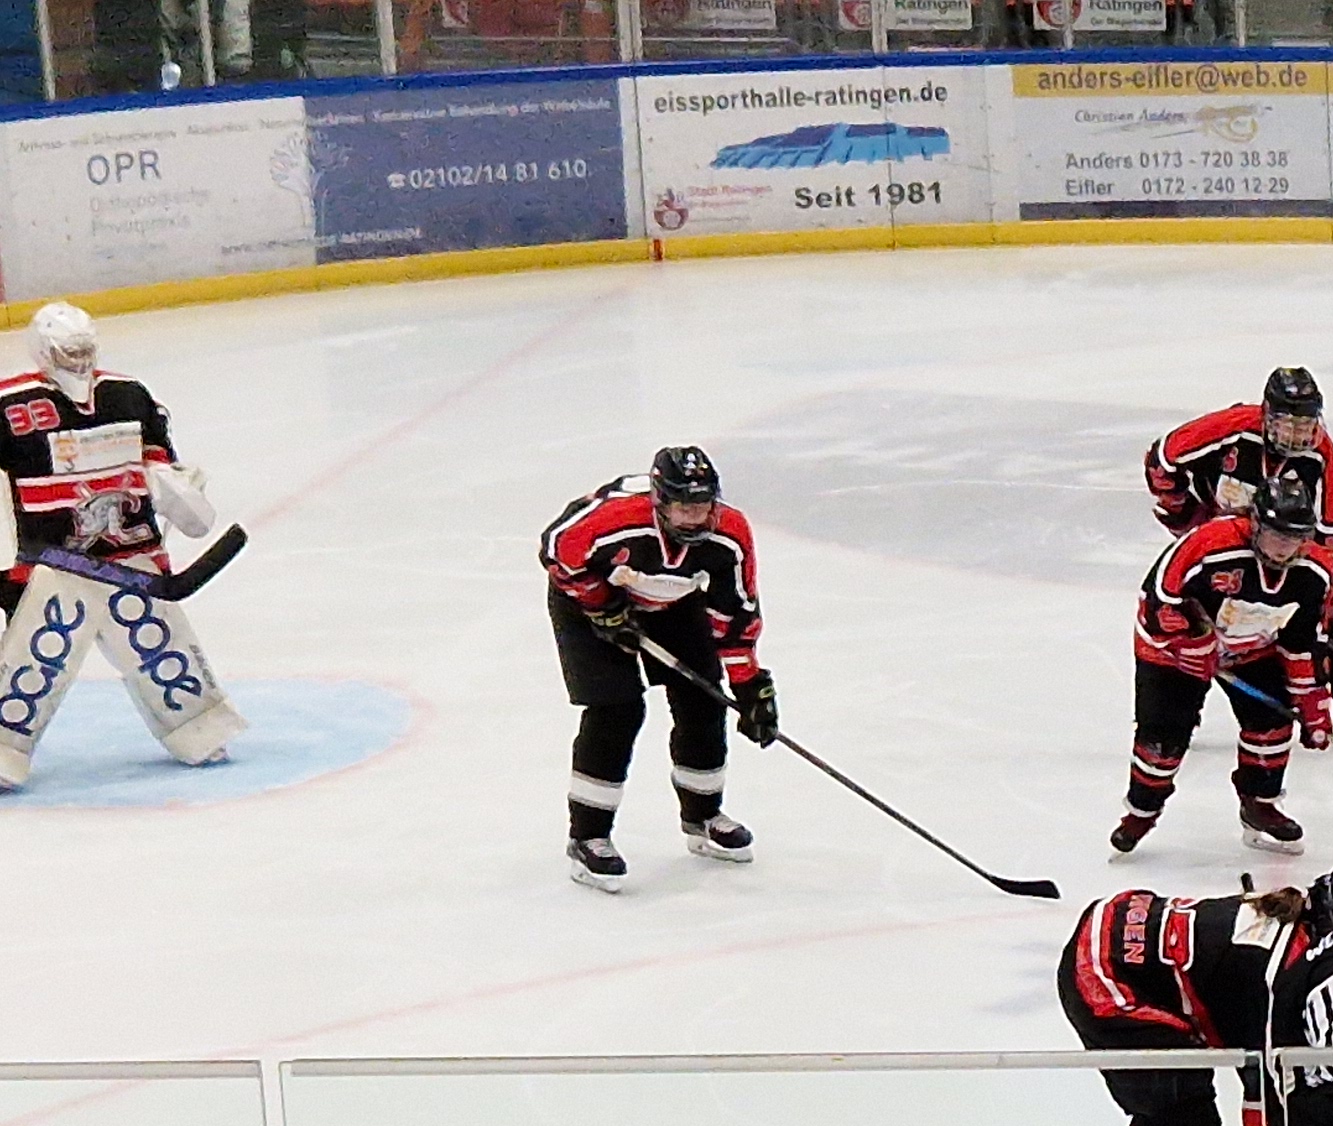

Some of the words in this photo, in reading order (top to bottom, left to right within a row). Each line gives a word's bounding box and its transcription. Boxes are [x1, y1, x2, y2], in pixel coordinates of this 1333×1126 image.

[1038, 64, 1308, 93] anders-eifler@web.de
[654, 81, 948, 116] eissporthalle-ratingen.de
[87, 150, 162, 186] OPR
[548, 159, 587, 180] 610
[1065, 152, 1133, 170] Anders
[1140, 152, 1182, 169] 0173
[1203, 152, 1233, 168] 720
[1240, 152, 1261, 168] 38
[1267, 152, 1289, 168] 38
[794, 186, 856, 209] Seit
[868, 181, 943, 206] 1981
[1065, 177, 1115, 196] Eifler
[1142, 177, 1185, 195] 0172
[1203, 177, 1235, 194] 240
[1243, 177, 1263, 193] 12
[1268, 177, 1289, 193] 29
[4, 398, 61, 437] 33
